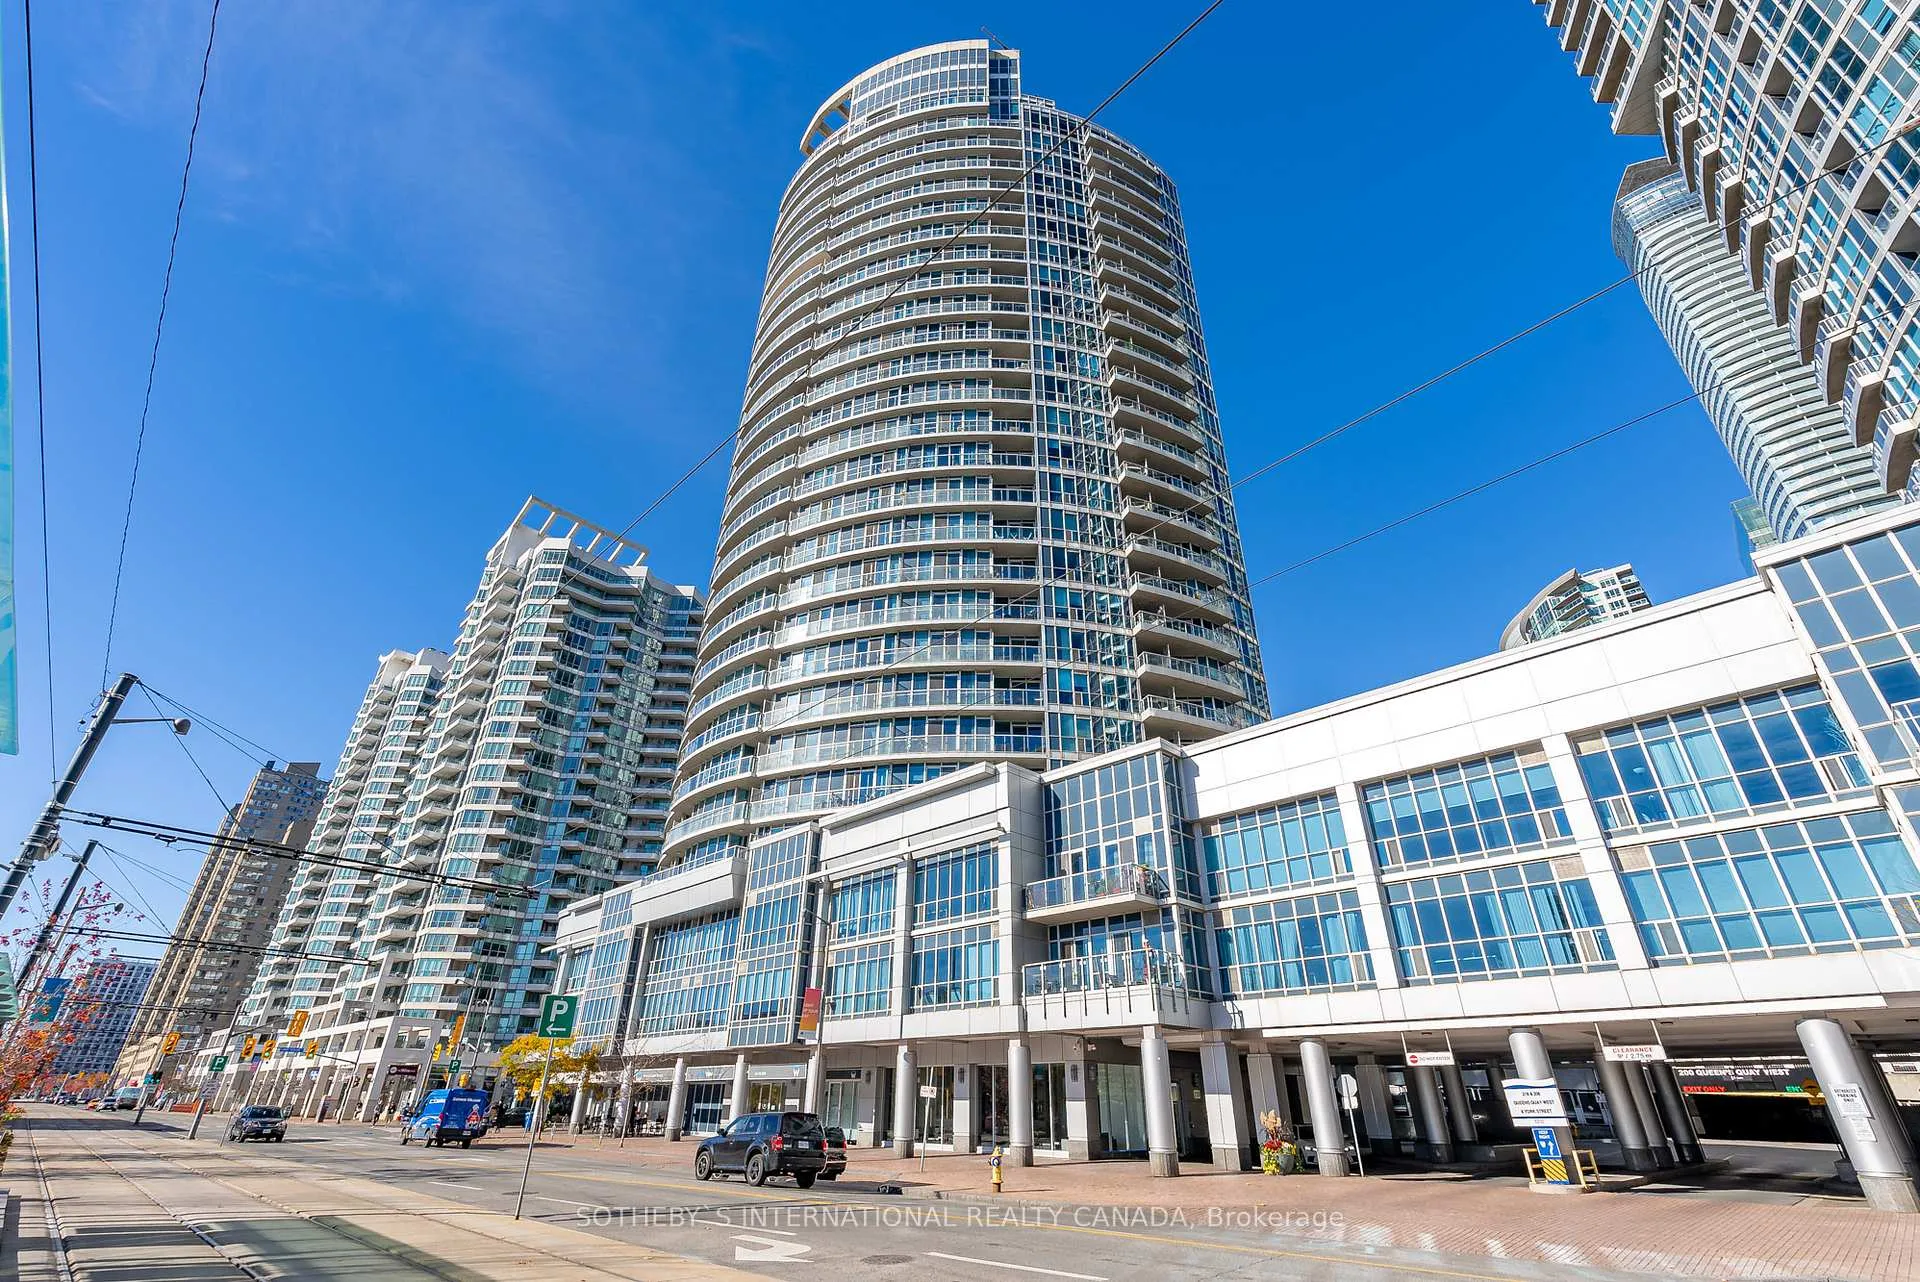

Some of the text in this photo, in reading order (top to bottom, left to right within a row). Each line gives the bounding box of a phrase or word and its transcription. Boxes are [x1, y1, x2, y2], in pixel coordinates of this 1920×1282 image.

[550, 1000, 569, 1022] P
[215, 1057, 225, 1066] P
[452, 1061, 459, 1069] P
